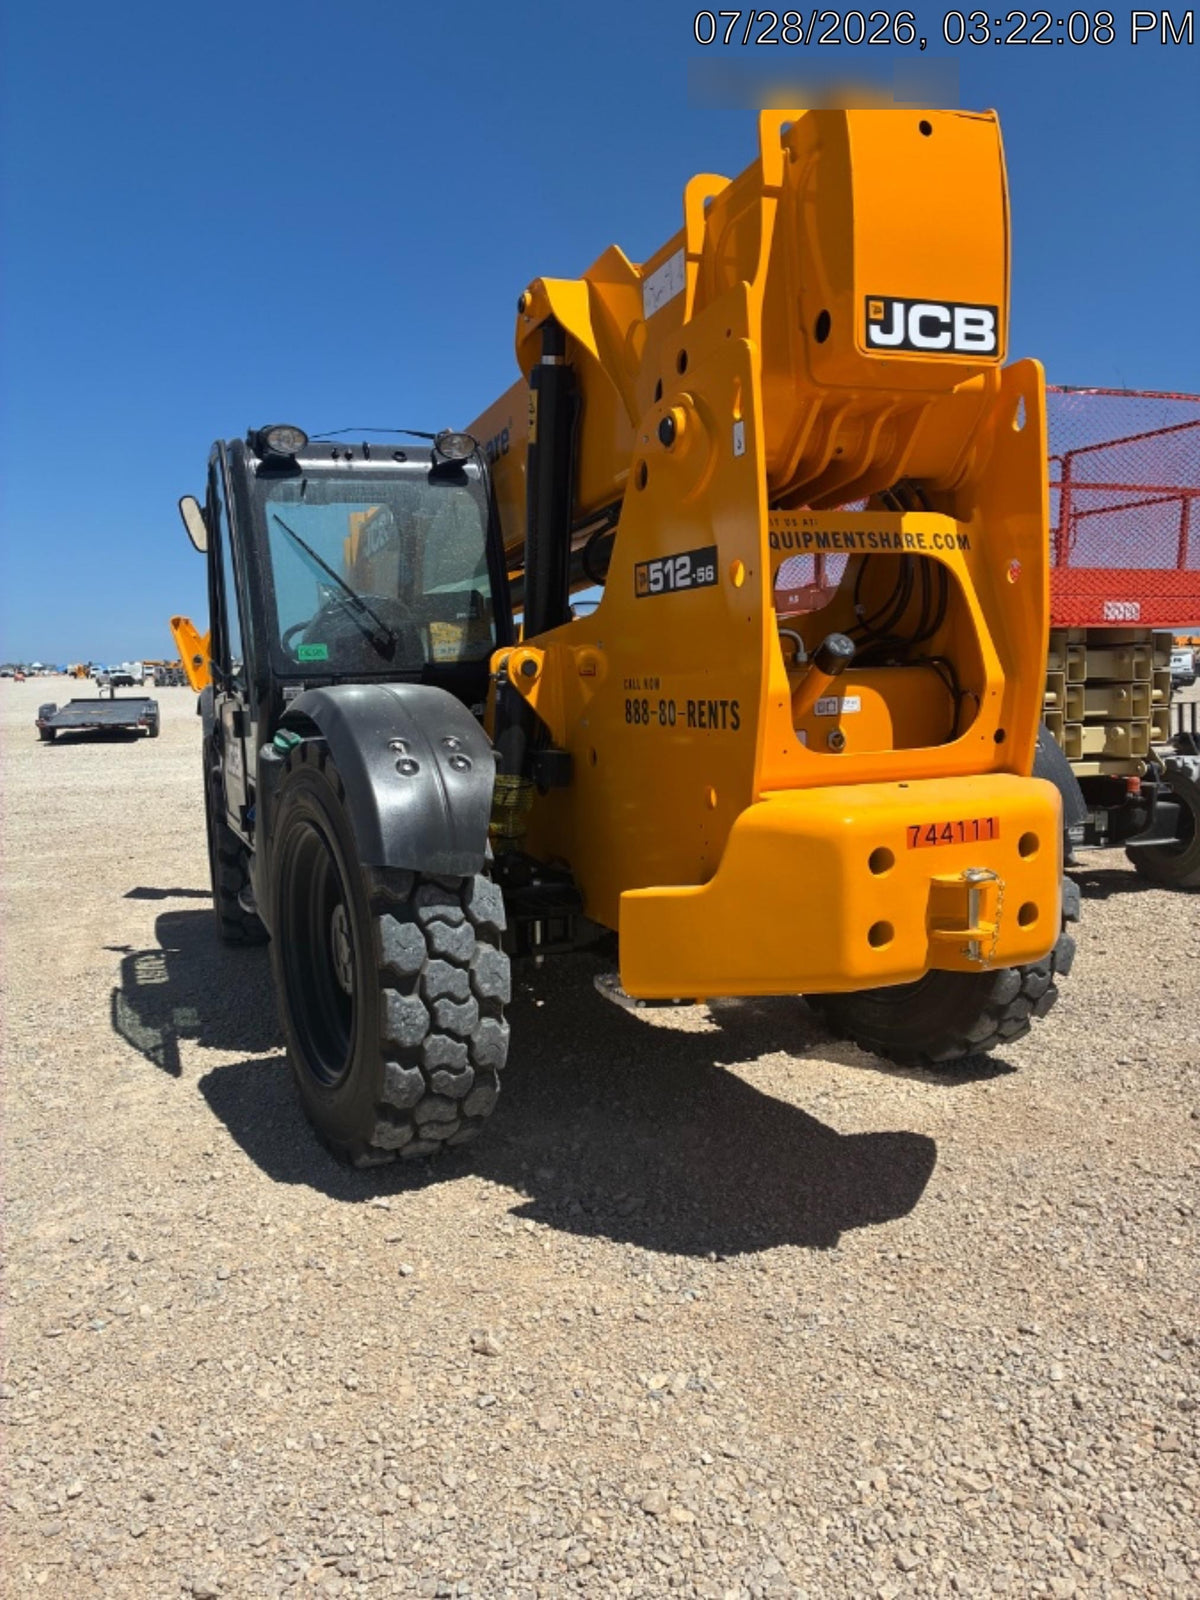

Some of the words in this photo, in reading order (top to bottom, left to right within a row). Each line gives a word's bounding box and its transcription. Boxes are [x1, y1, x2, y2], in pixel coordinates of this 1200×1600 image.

[868, 301, 997, 352] JCB
[623, 678, 641, 690] CALL
[643, 678, 660, 690] NOW
[624, 698, 741, 731] 888-80-RENTS
[908, 817, 994, 848] 744111
